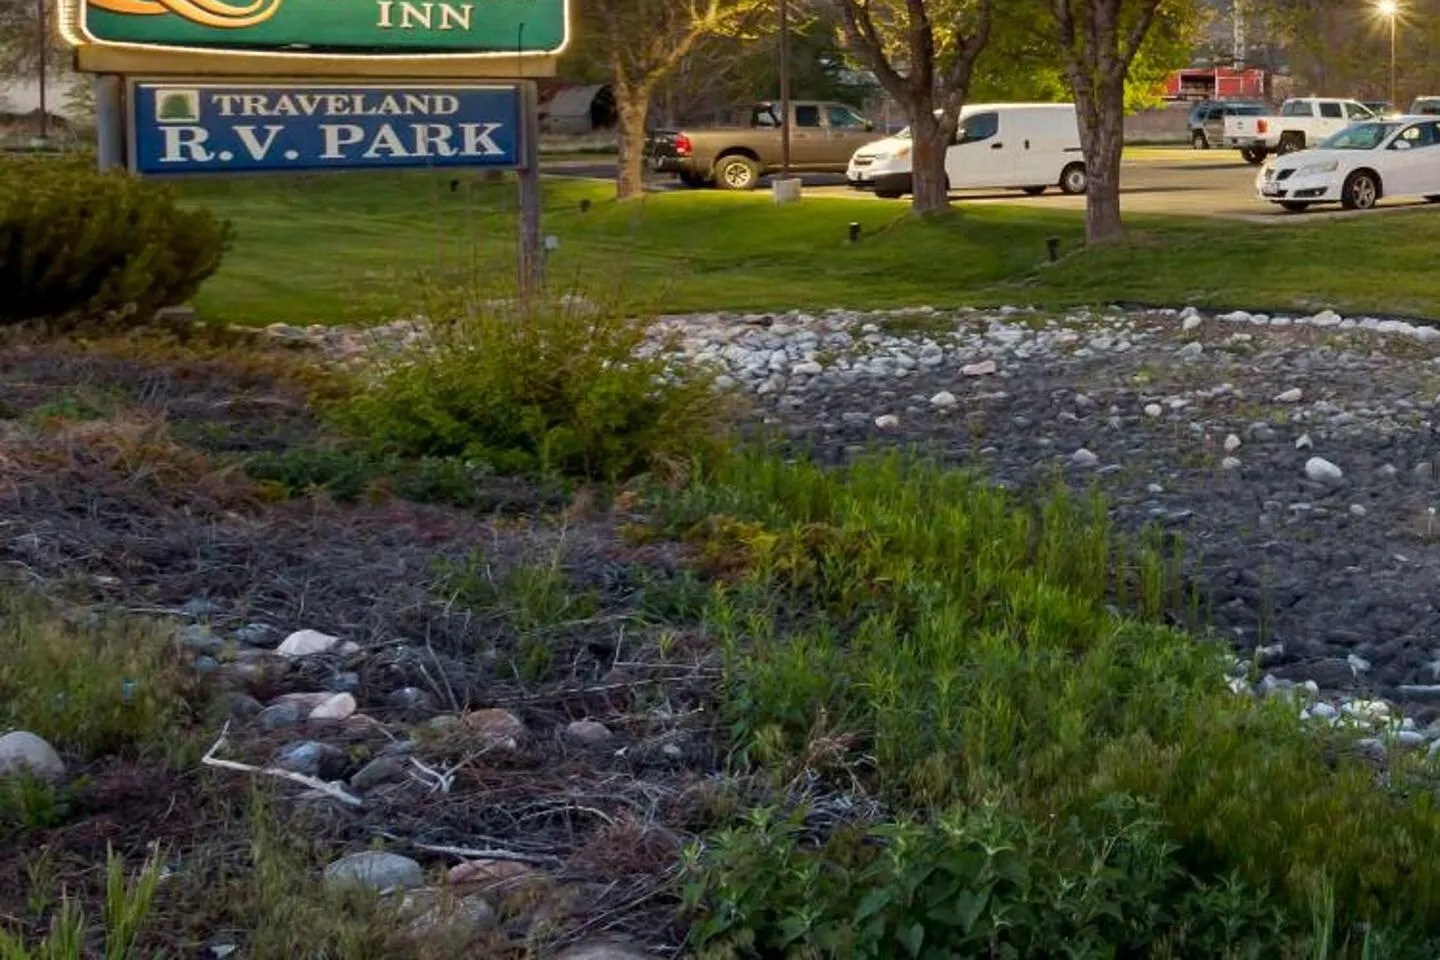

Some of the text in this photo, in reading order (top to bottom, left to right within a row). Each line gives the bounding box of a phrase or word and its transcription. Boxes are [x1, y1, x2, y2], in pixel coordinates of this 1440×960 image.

[376, 0, 474, 30] INN
[211, 94, 460, 117] TRAVELAND
[157, 122, 506, 162] R.V. PARK
